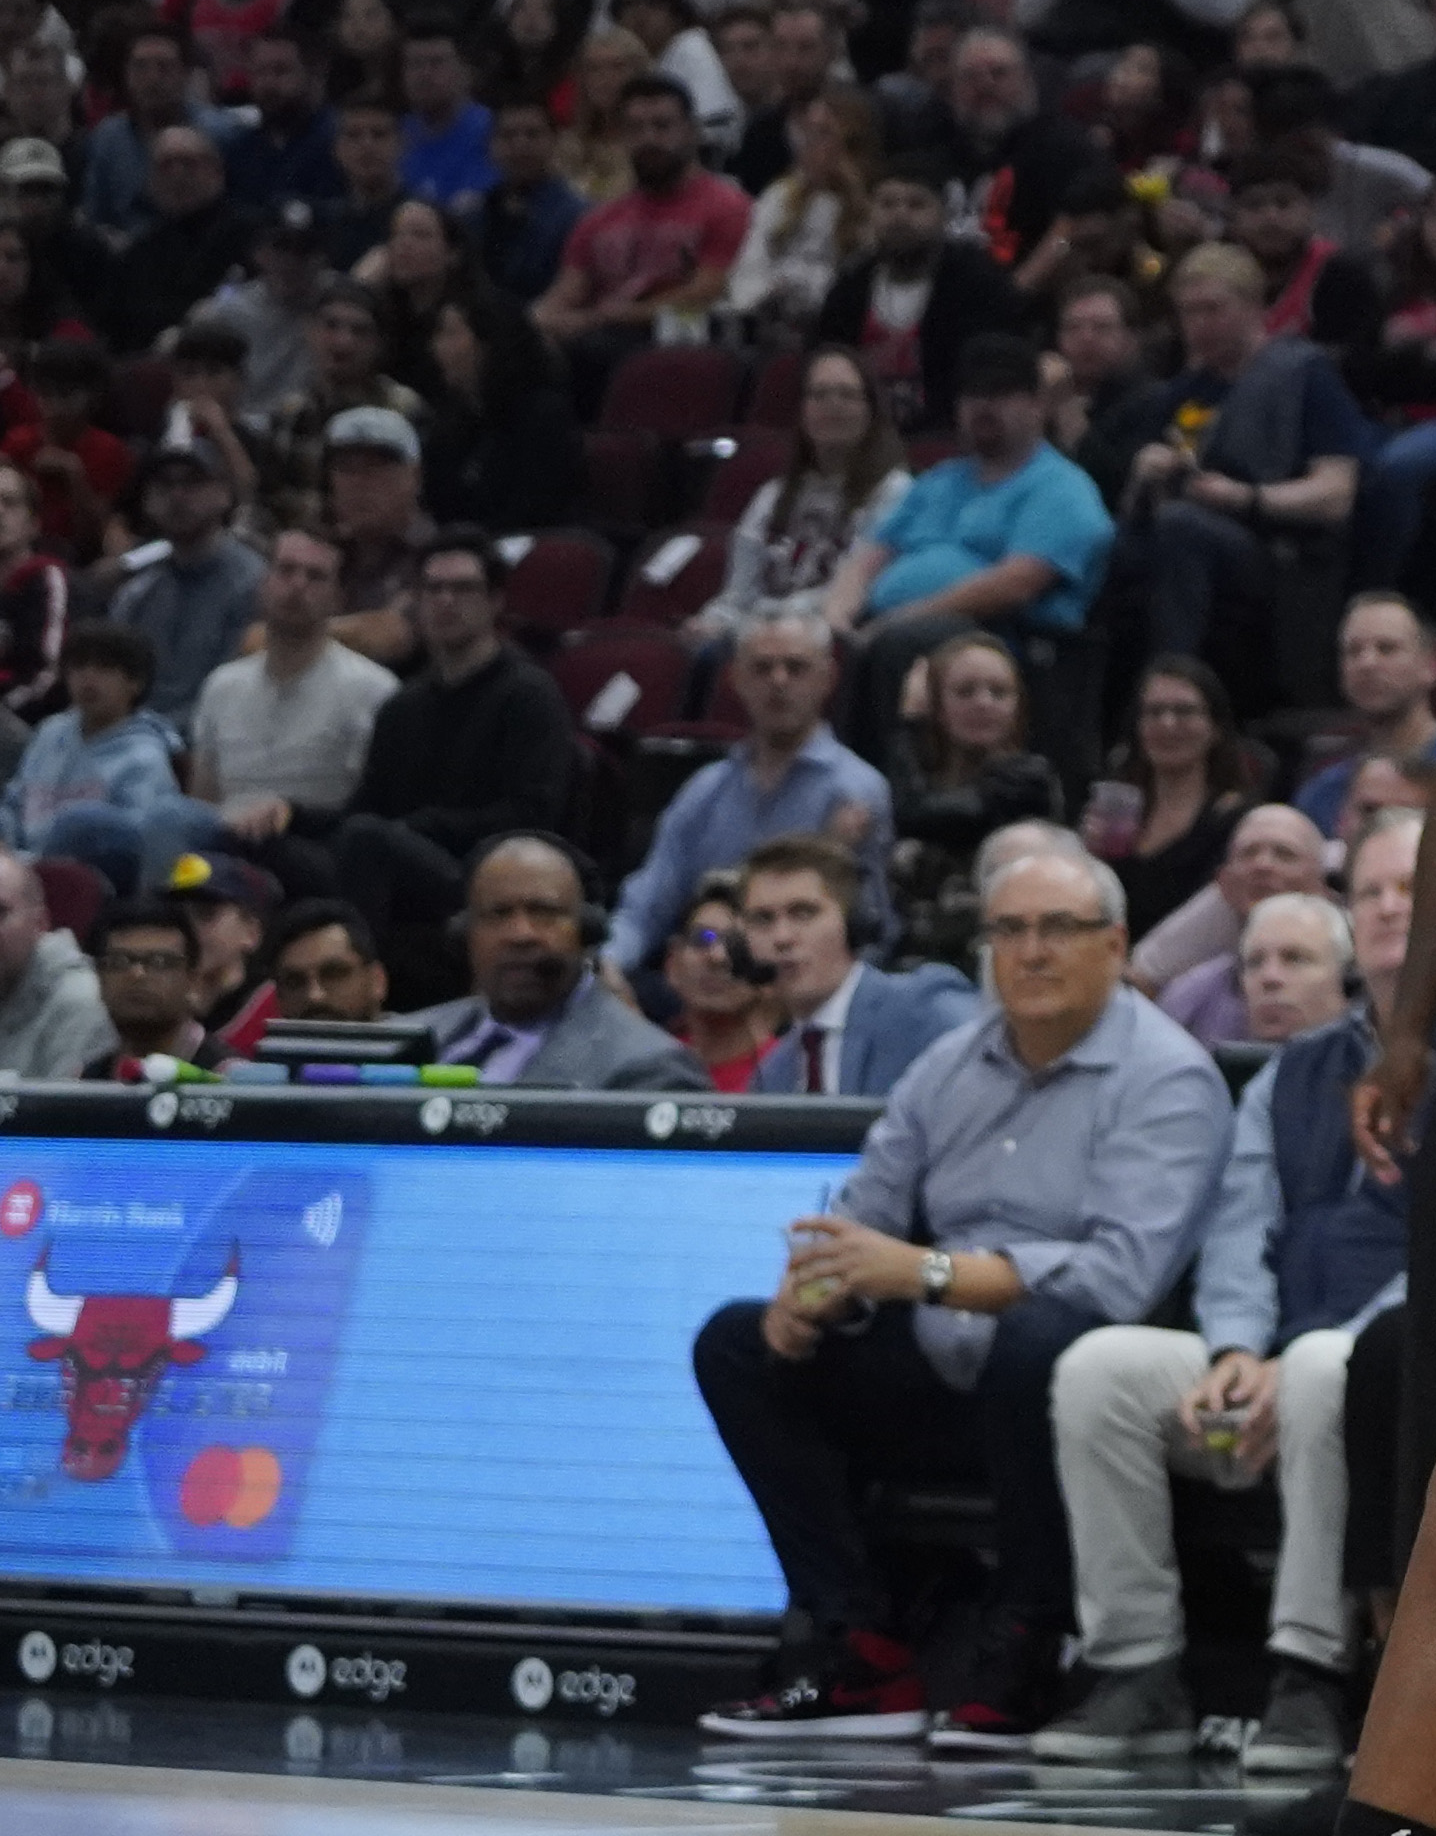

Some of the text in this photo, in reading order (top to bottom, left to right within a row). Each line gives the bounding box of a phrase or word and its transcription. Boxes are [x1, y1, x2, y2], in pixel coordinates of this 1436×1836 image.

[62, 1641, 135, 1688] edge
[331, 1652, 407, 1702] edge
[558, 1666, 636, 1716] edge
